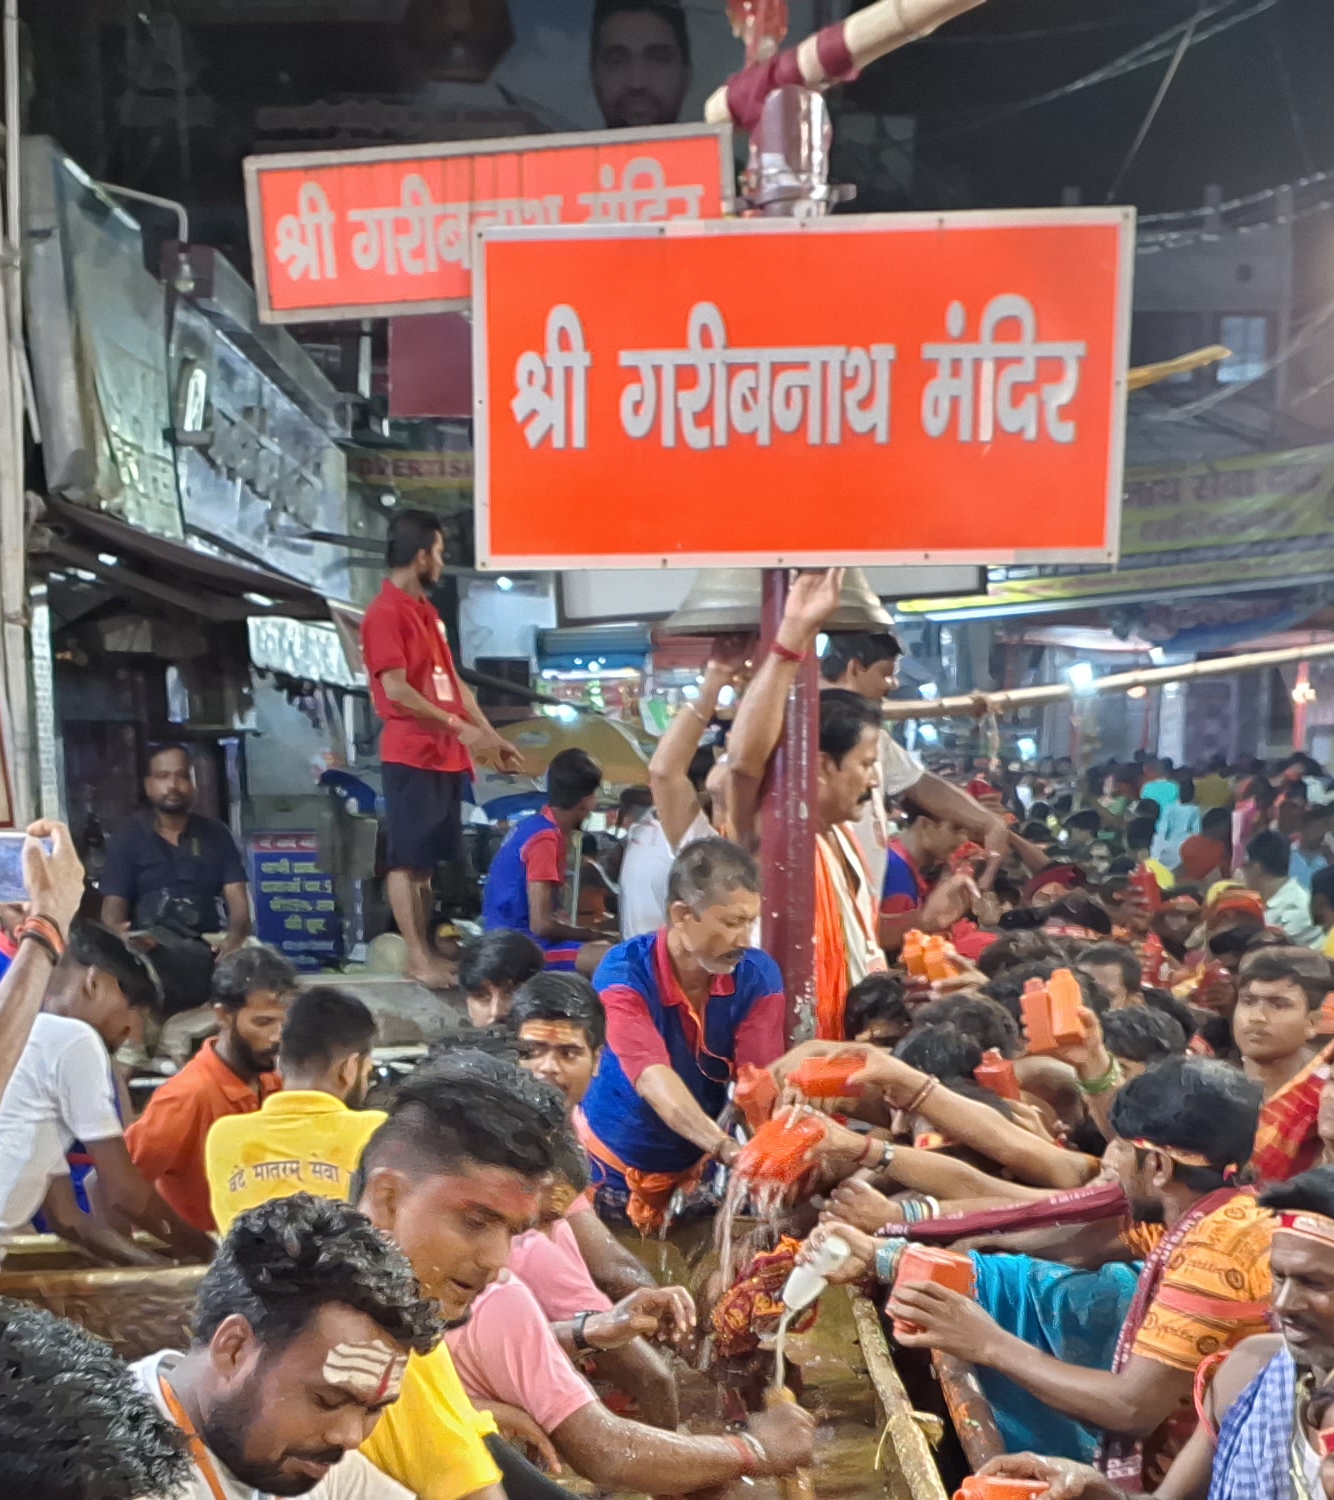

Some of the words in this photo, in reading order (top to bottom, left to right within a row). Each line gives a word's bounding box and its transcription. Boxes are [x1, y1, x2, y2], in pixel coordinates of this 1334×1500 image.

[274, 181, 338, 281] श्री
[510, 303, 592, 450] श्री
[618, 301, 895, 449] गरीबनाथ
[921, 293, 1086, 456] मंदिर
[253, 1160, 305, 1182] मातरम्
